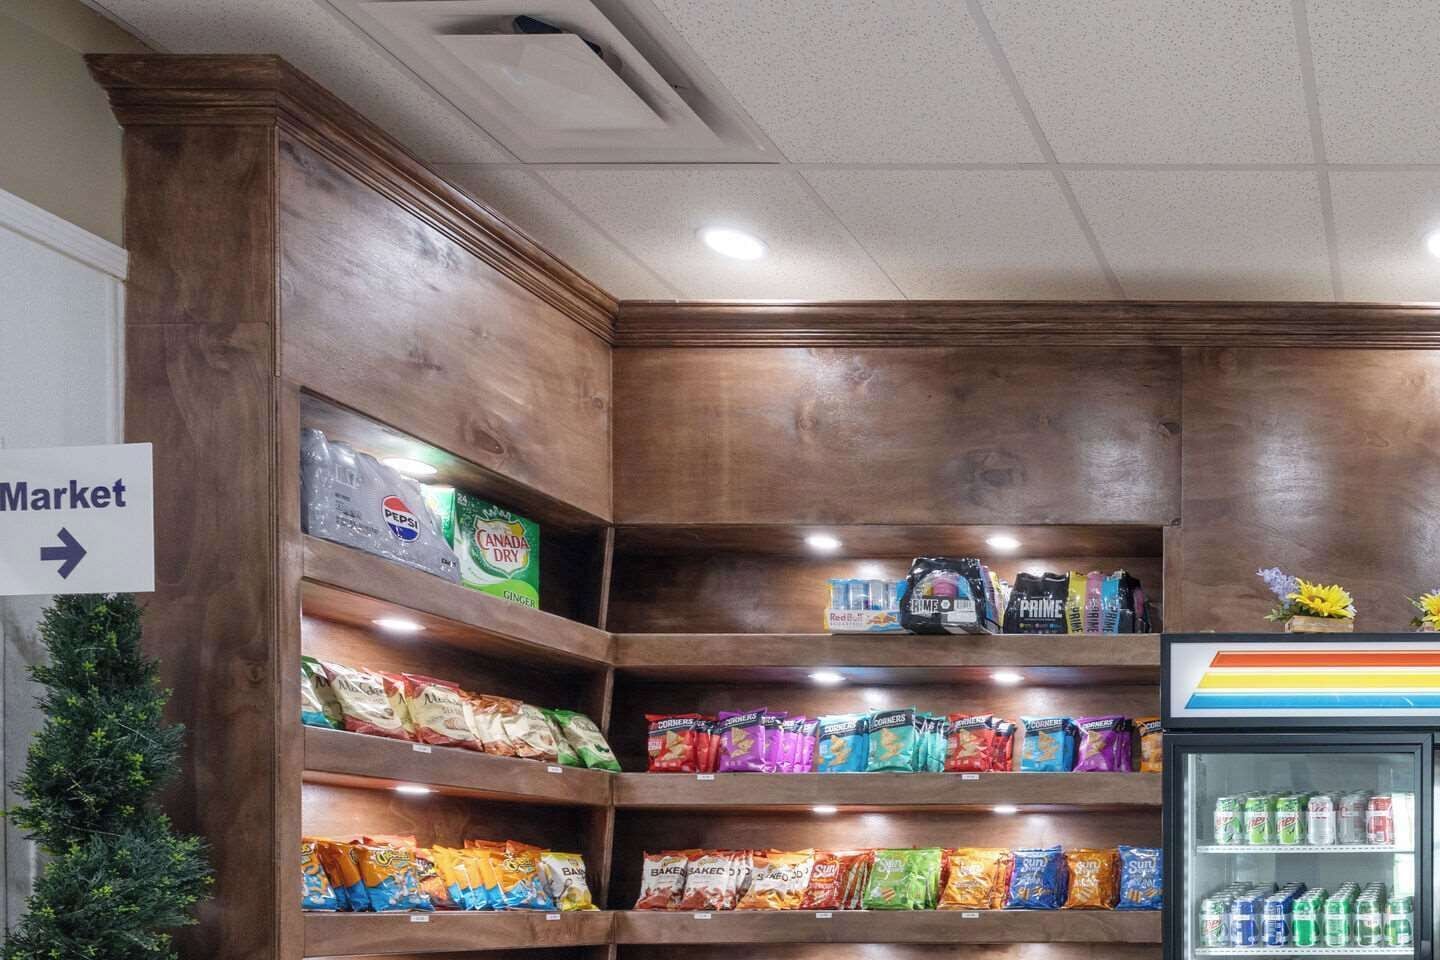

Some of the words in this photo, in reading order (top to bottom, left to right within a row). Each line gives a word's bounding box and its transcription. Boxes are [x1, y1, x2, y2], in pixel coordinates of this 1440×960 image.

[0, 478, 126, 512] Market
[385, 508, 418, 529] PEPSI
[476, 529, 529, 550] CANADA
[494, 548, 519, 563] DRY
[503, 590, 536, 608] GINGER
[1020, 599, 1063, 618] PRIME
[830, 613, 846, 621] Red
[658, 718, 694, 729] CORNERS
[874, 713, 906, 727] CORNERS
[651, 866, 688, 877] BAKED
[687, 866, 725, 876] BAKED
[814, 863, 838, 878] Sun
[1023, 858, 1045, 872] Sun
[1076, 861, 1099, 872] Sun
[1129, 859, 1156, 874] Sun
